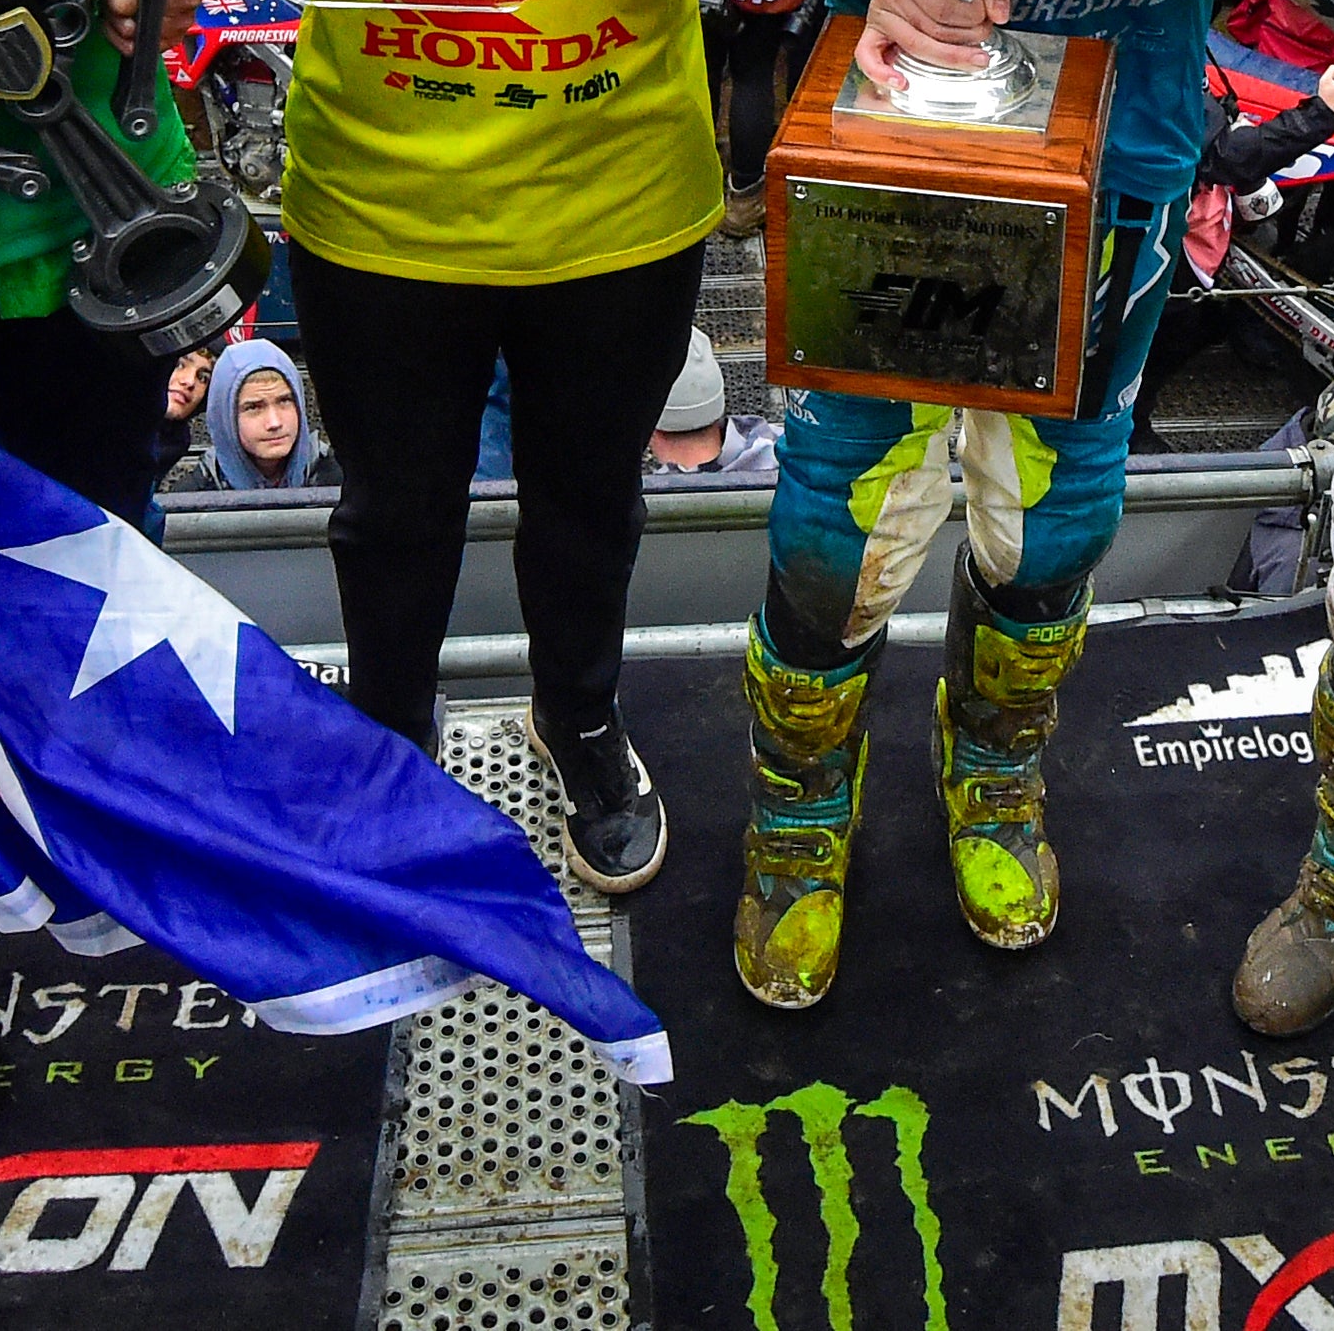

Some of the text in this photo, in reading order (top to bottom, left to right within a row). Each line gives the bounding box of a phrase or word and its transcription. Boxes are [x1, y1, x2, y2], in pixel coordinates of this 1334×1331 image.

[218, 29, 299, 43] PROGRESSIV
[360, 15, 638, 72] HONDA
[412, 74, 476, 98] boost
[414, 89, 457, 102] mobile
[1134, 723, 1315, 773] Empirelog
